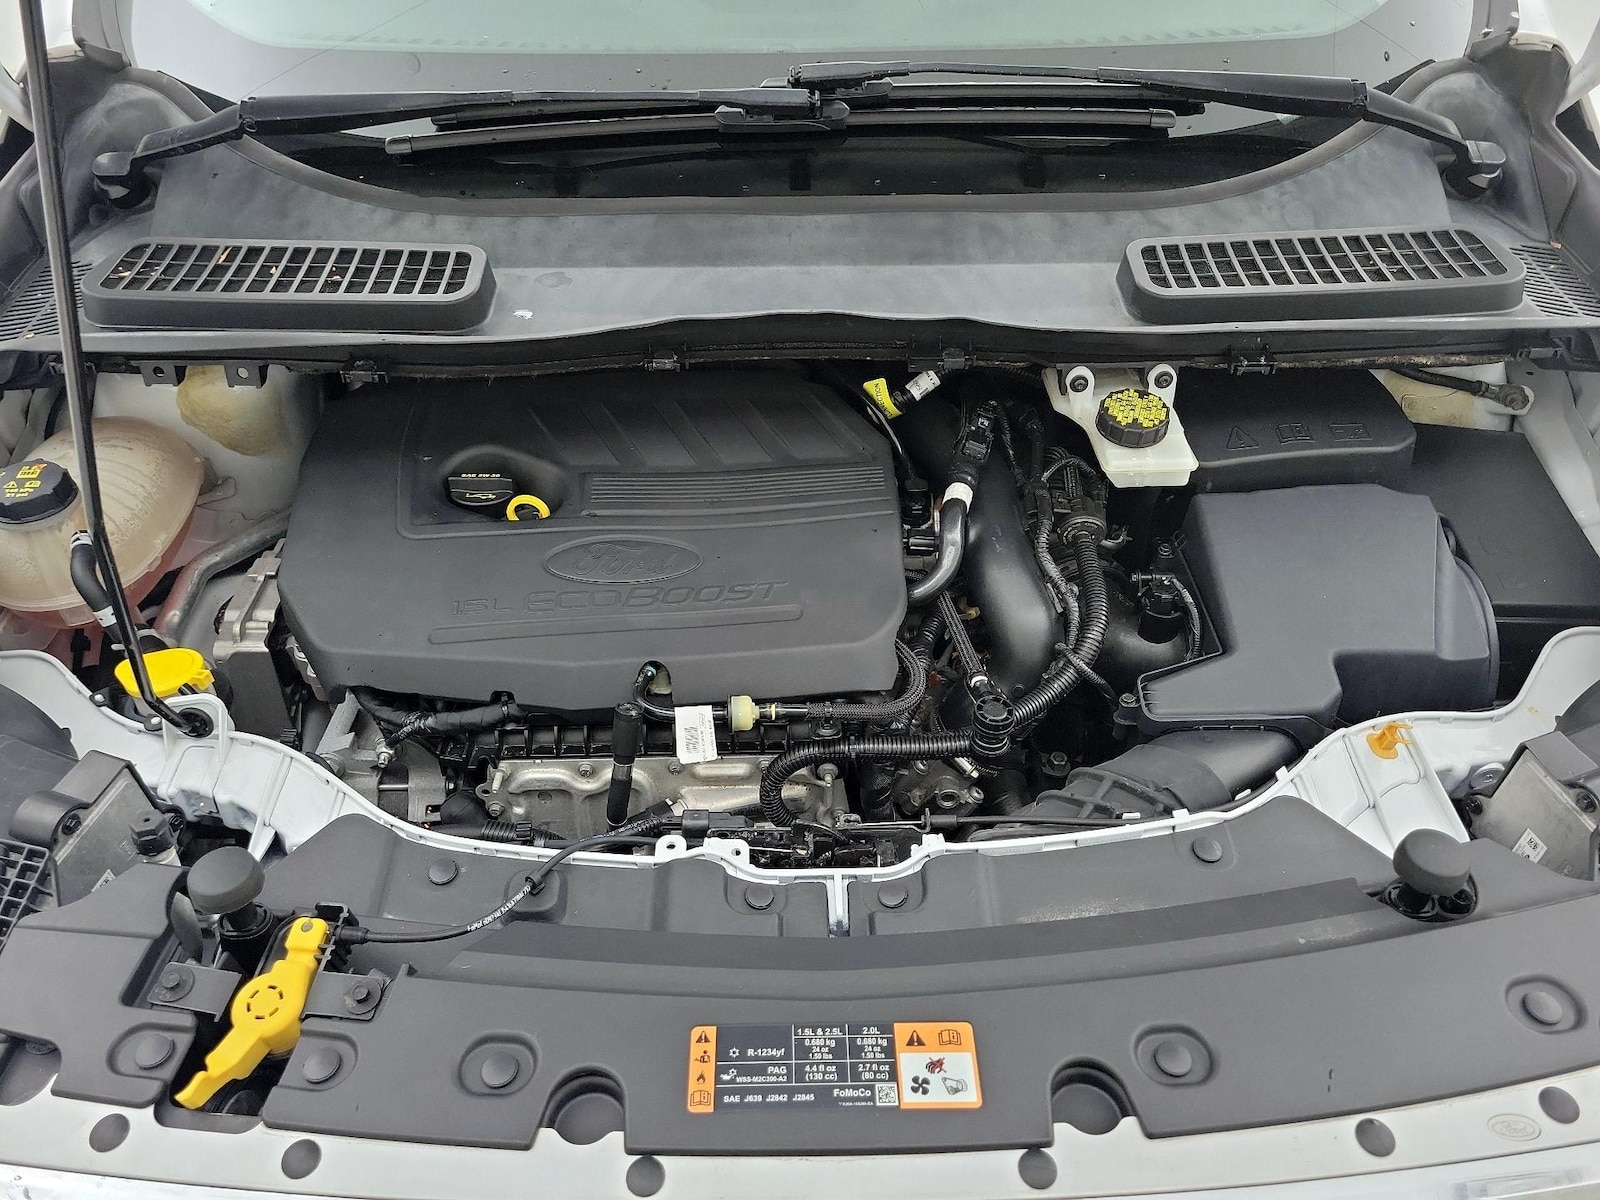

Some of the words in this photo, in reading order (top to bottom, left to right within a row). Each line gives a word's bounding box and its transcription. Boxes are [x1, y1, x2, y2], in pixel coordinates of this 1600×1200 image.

[573, 543, 678, 576] Ford
[797, 1028, 815, 1036] 1.5L
[825, 1027, 843, 1035] 2.5L
[862, 1026, 881, 1034] 2.0L
[826, 1038, 836, 1047] kg
[878, 1037, 888, 1046] kg
[747, 1048, 786, 1058] R-1234yf
[767, 1066, 787, 1074] PAG
[805, 1072, 823, 1081] (130
[824, 1072, 838, 1081] cc)
[861, 1071, 874, 1081] (80
[876, 1071, 889, 1080] cc)
[833, 1088, 872, 1097] FoMoCo
[744, 1094, 763, 1102] J639
[766, 1094, 788, 1102] J2842
[792, 1093, 815, 1101] J2845
